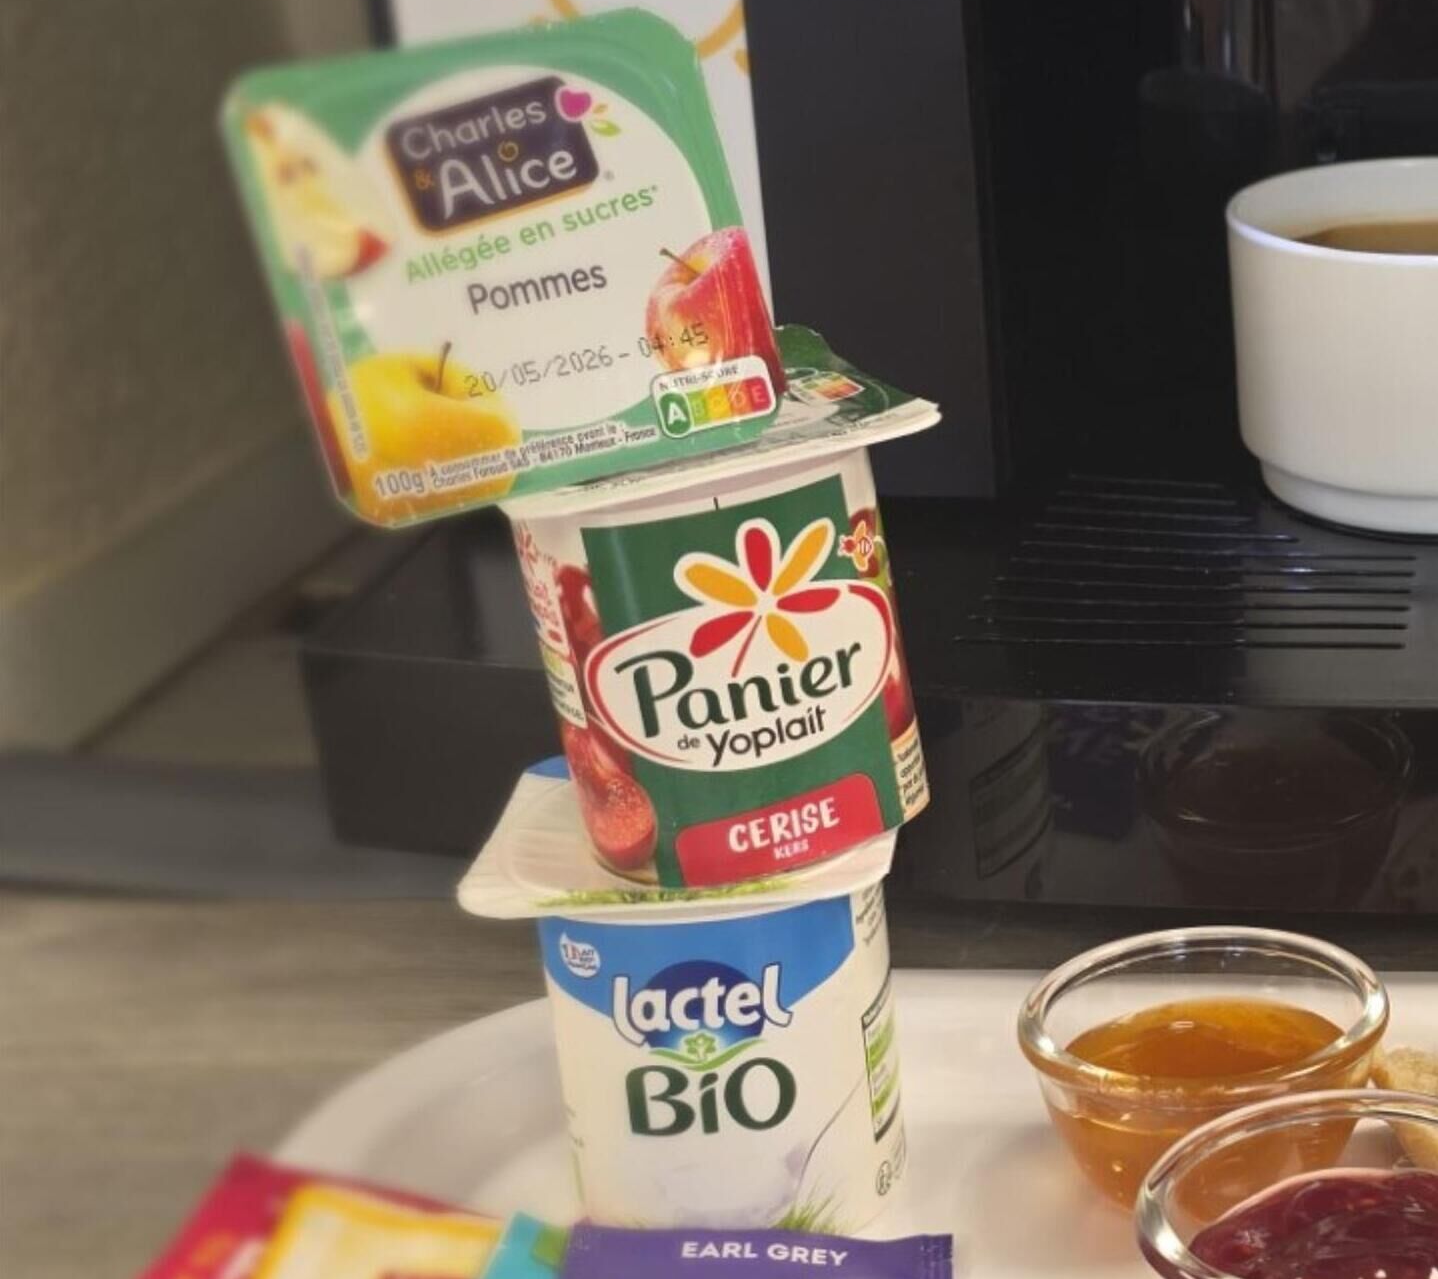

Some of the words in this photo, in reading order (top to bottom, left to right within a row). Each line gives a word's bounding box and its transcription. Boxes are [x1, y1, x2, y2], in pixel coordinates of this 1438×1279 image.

[402, 101, 547, 160] Charles
[439, 142, 577, 219] Alice
[406, 235, 511, 284] Allégée
[519, 222, 556, 246] en
[466, 263, 608, 315] Pommes
[464, 344, 613, 399] 20/05/2026
[636, 322, 710, 359] 04:45
[667, 402, 688, 426] A
[750, 383, 765, 401] E
[376, 471, 425, 497] 100g
[614, 641, 861, 739] Panier
[677, 733, 700, 751] de
[728, 796, 840, 853] CERISE
[611, 962, 793, 1047] lactel
[680, 1241, 759, 1260] EARL
[766, 1242, 849, 1267] GREY
